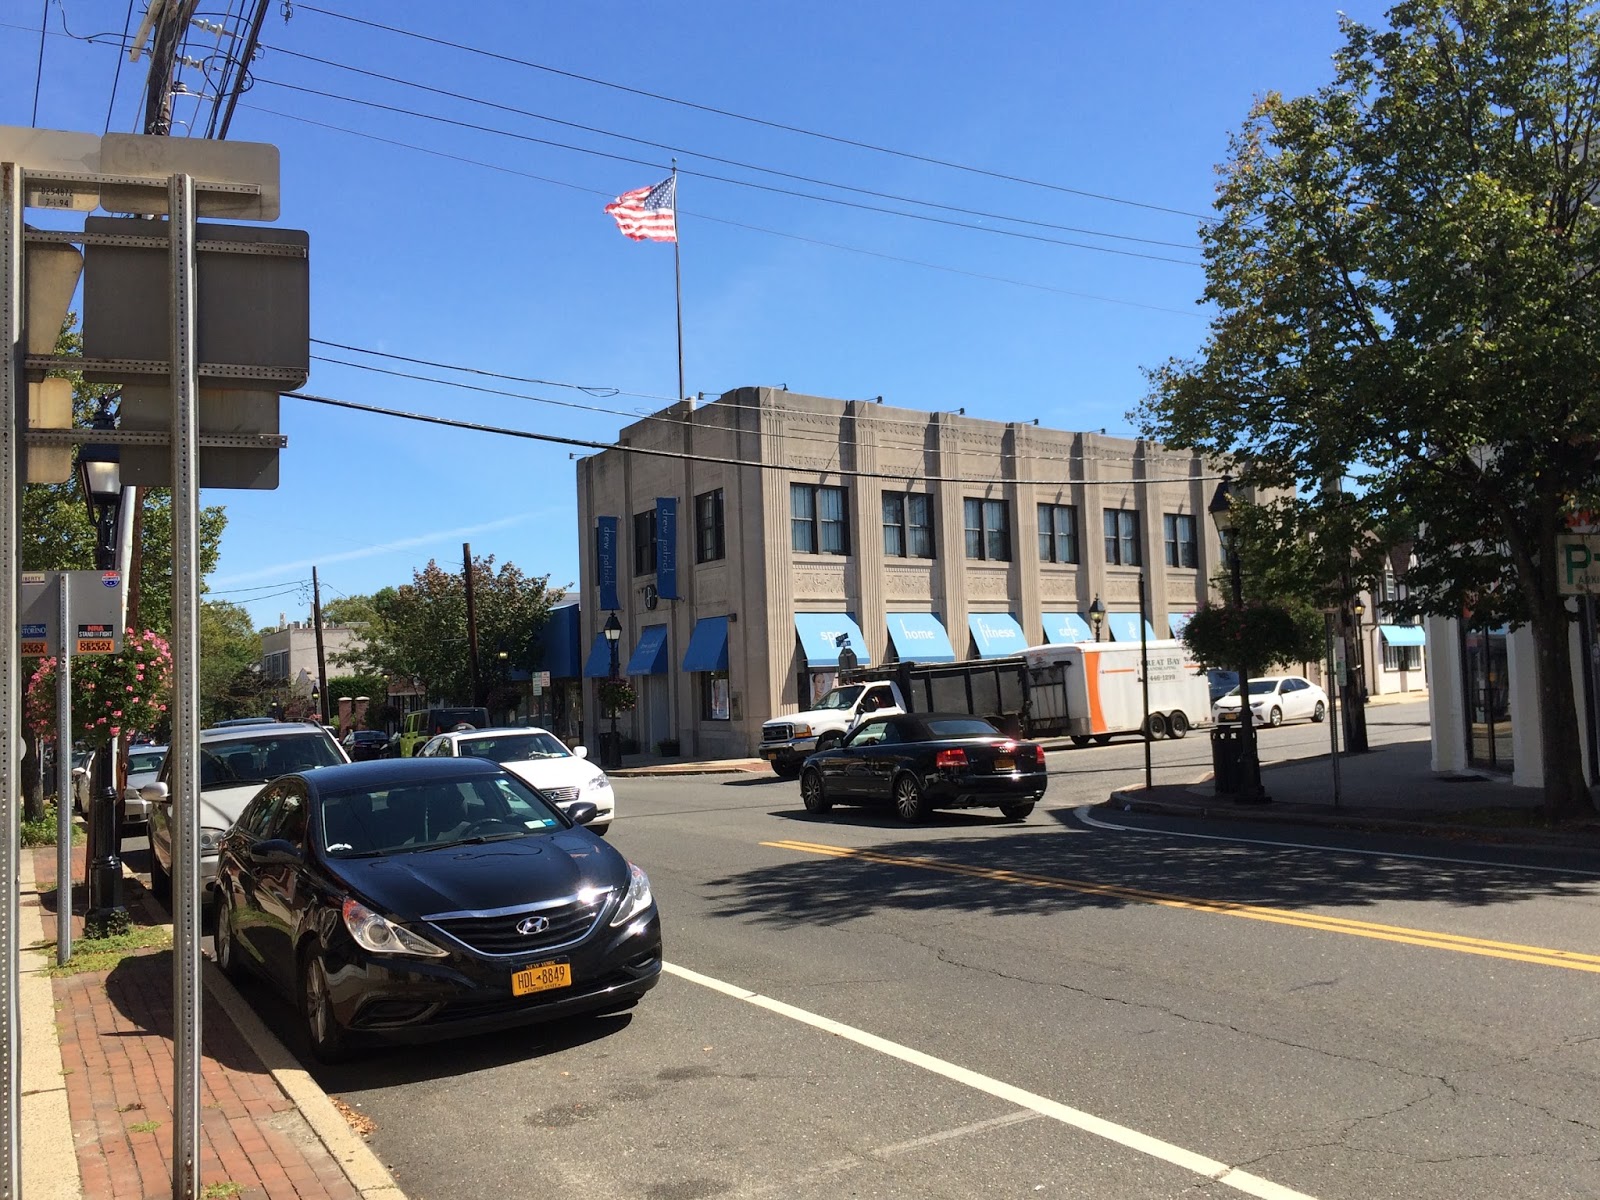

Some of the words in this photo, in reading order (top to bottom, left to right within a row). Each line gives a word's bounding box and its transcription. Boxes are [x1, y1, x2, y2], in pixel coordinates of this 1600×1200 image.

[662, 508, 675, 534] drew
[603, 526, 616, 550] drew
[658, 539, 675, 574] patrick
[600, 554, 616, 586] patrick
[900, 618, 935, 639] home
[977, 617, 1016, 647] fitness
[1058, 617, 1079, 642] cafe
[1167, 657, 1180, 665] BAY
